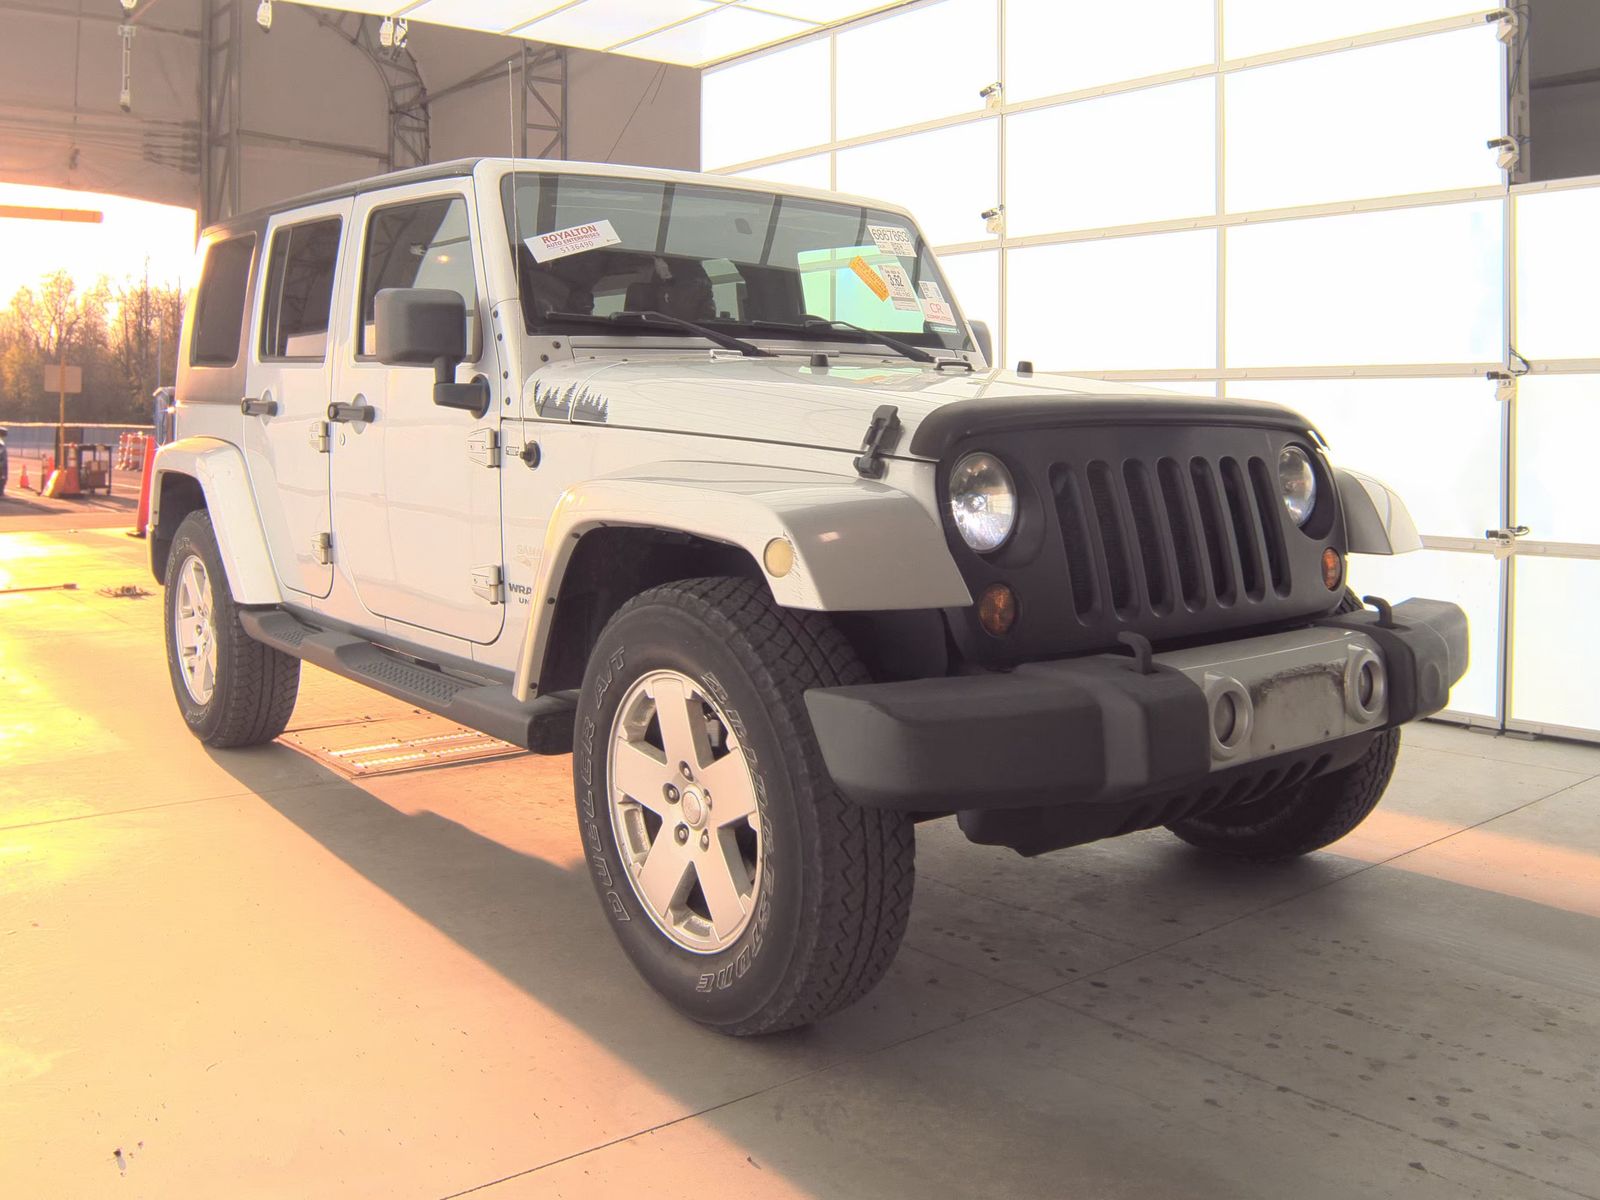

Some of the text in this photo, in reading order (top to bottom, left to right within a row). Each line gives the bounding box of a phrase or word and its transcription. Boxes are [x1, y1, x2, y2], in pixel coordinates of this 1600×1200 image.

[541, 225, 597, 244] ROYALTON
[546, 232, 600, 249] AUTO ENTERPRISES
[559, 241, 594, 254] 5136490
[930, 303, 944, 314] CR
[578, 715, 632, 922] DUELER
